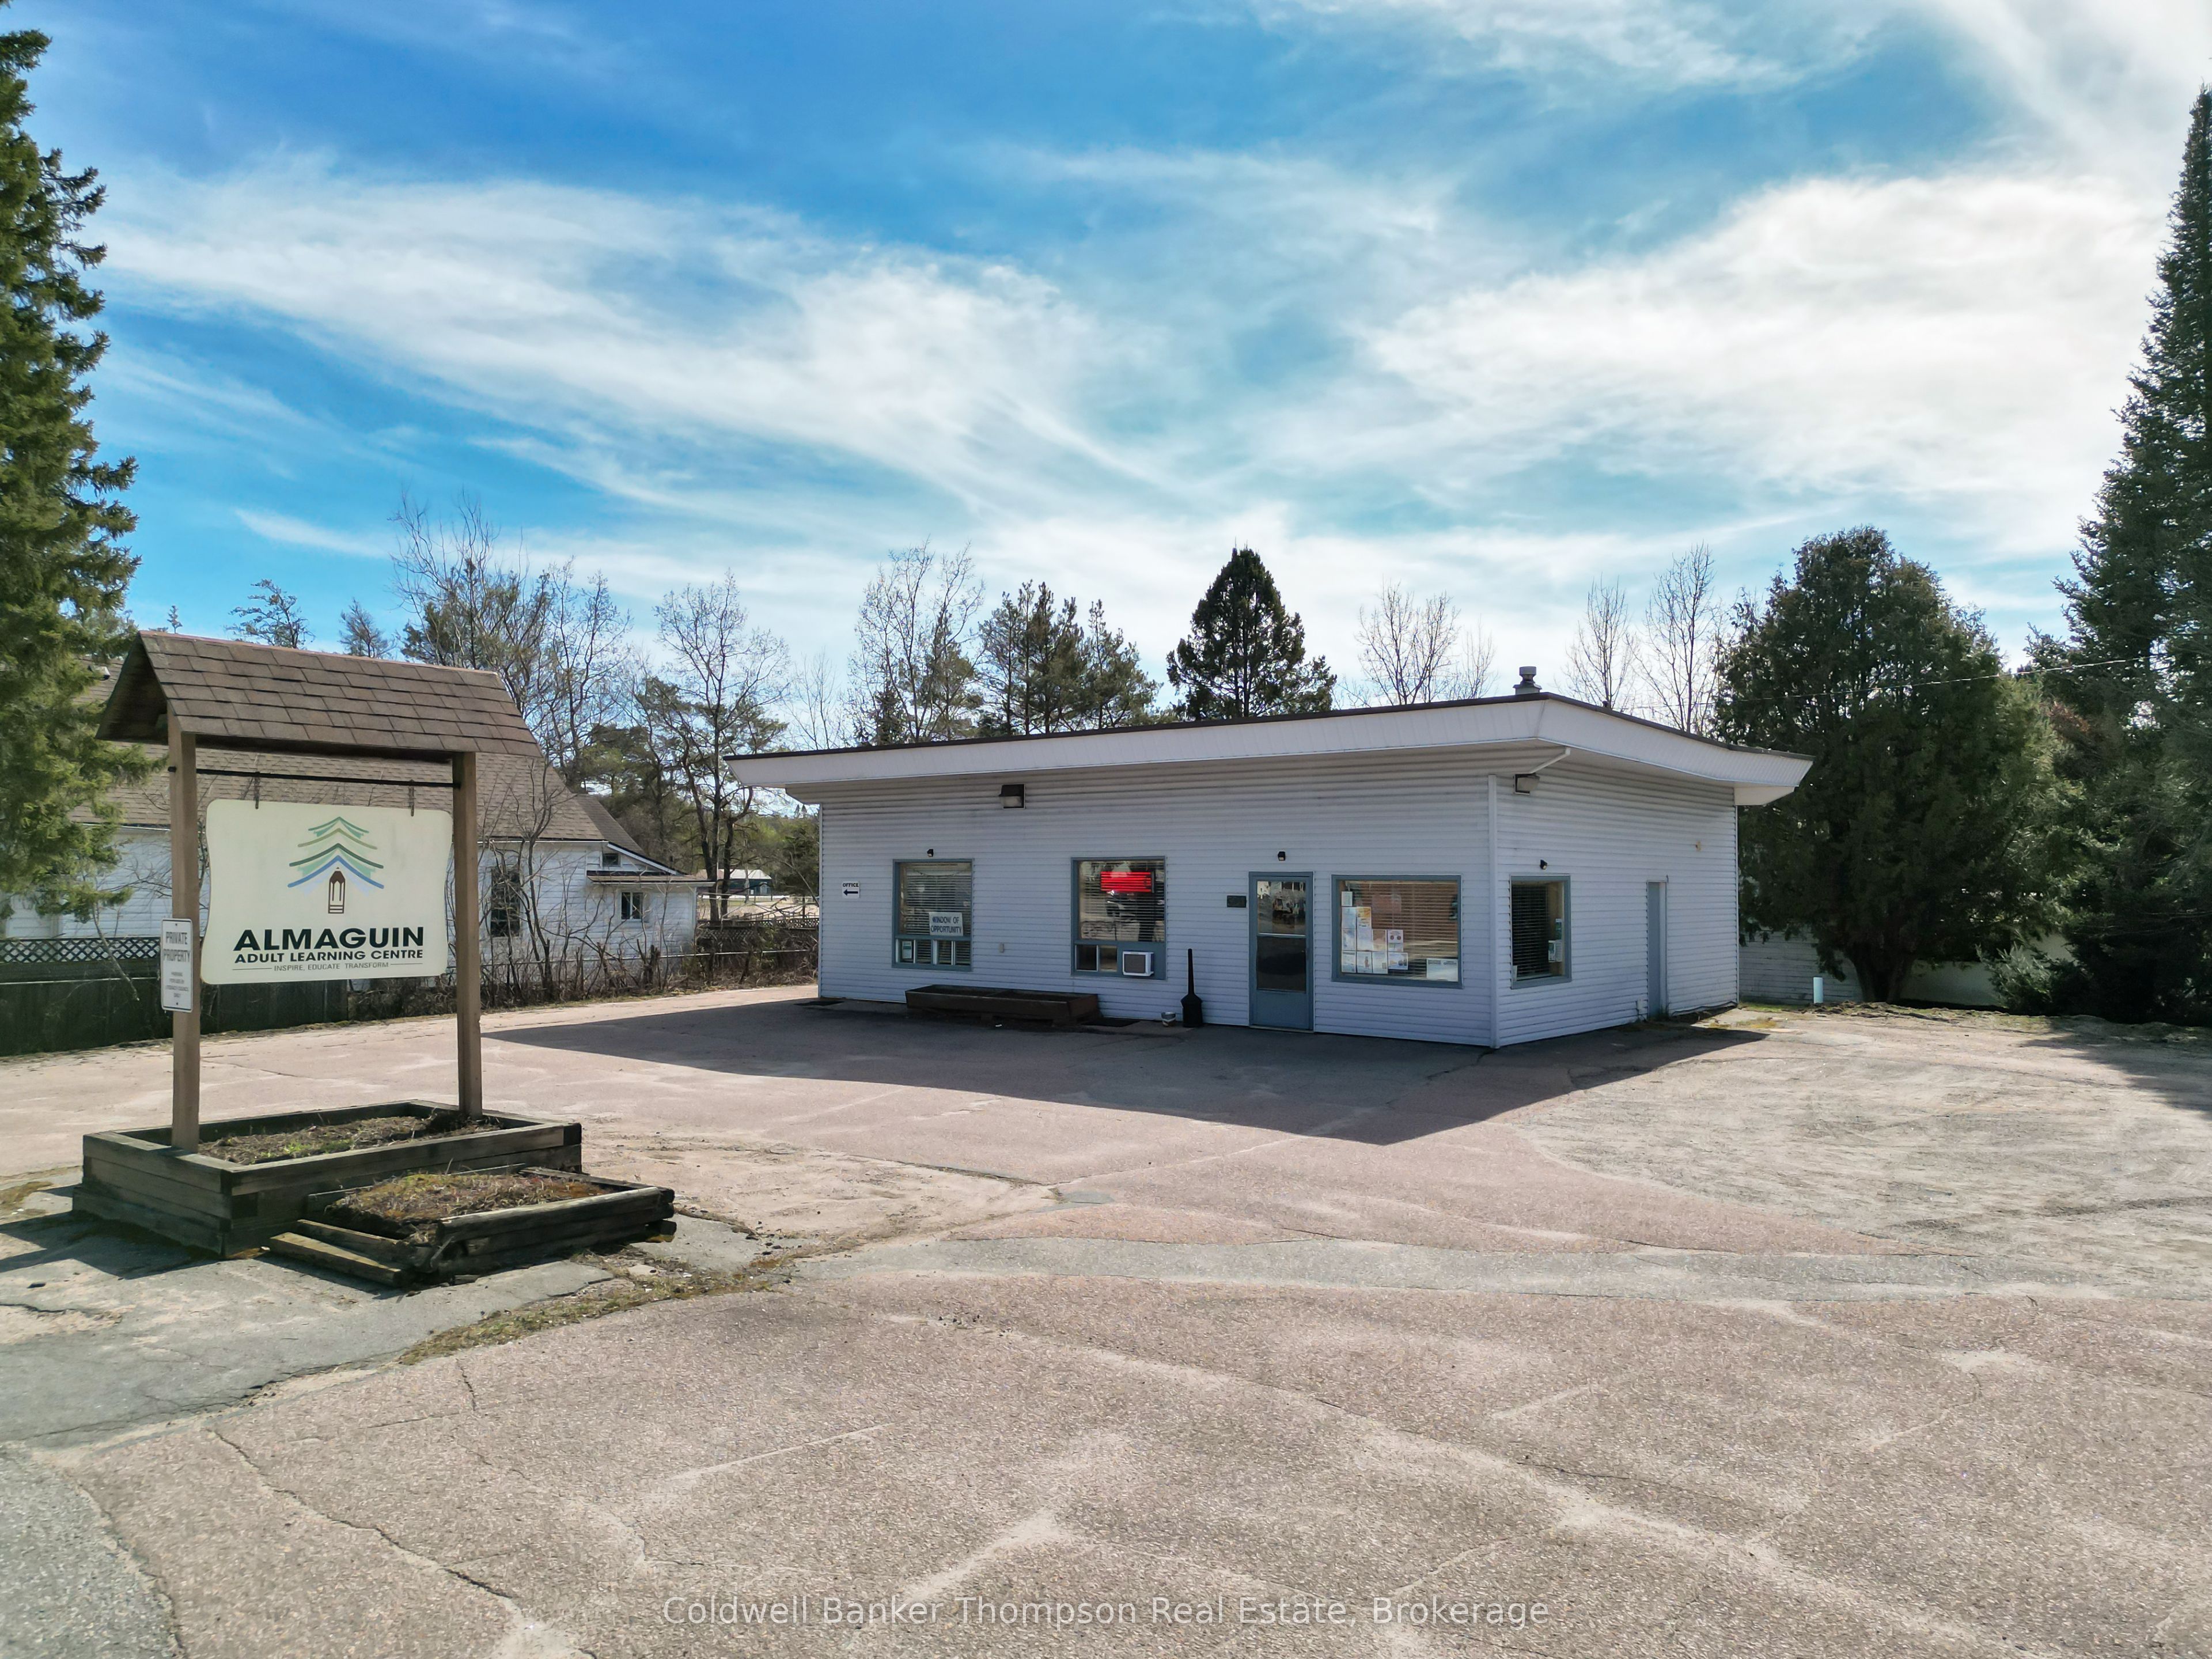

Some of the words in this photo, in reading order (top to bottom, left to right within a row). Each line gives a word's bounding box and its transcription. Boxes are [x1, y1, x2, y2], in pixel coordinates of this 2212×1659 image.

[931, 925, 962, 933] OPPORTUNITY
[165, 931, 188, 945] PRIVATE
[233, 927, 423, 951] ALMAGUIN
[163, 949, 191, 962] PROPERTY
[234, 953, 285, 963] ADULT
[290, 950, 366, 962] LEARNING
[370, 949, 423, 960] CENTRE
